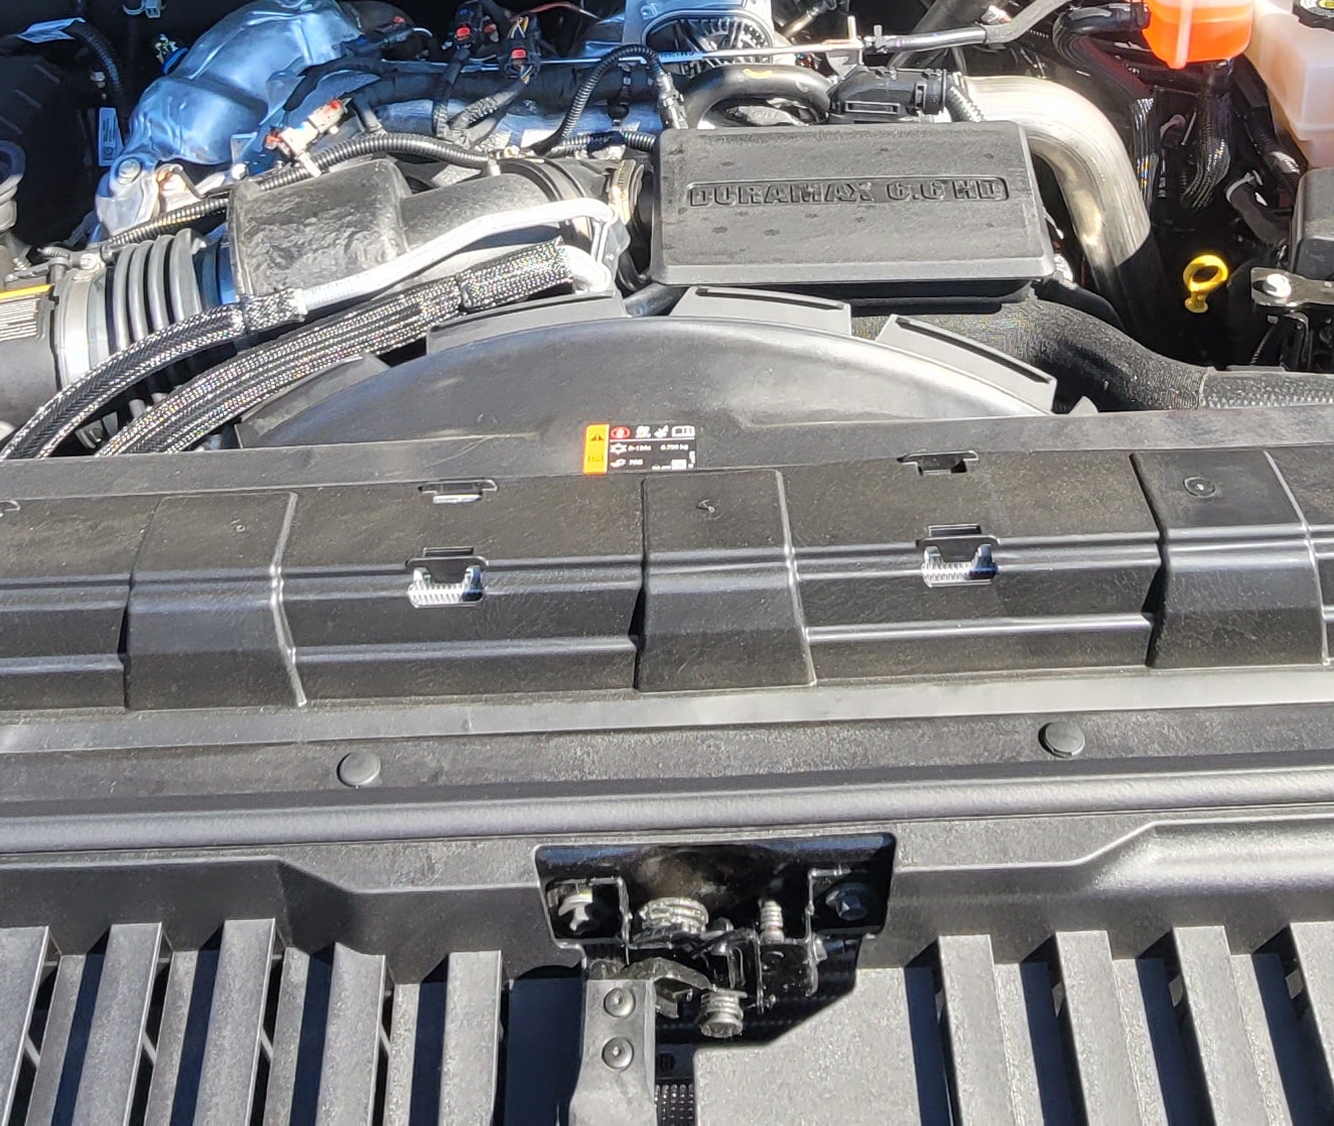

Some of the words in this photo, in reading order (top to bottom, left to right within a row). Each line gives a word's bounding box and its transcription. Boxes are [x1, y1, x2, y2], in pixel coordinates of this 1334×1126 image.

[689, 181, 874, 207] DURAMAX
[886, 179, 945, 201] 6.6
[952, 178, 1006, 201] HD
